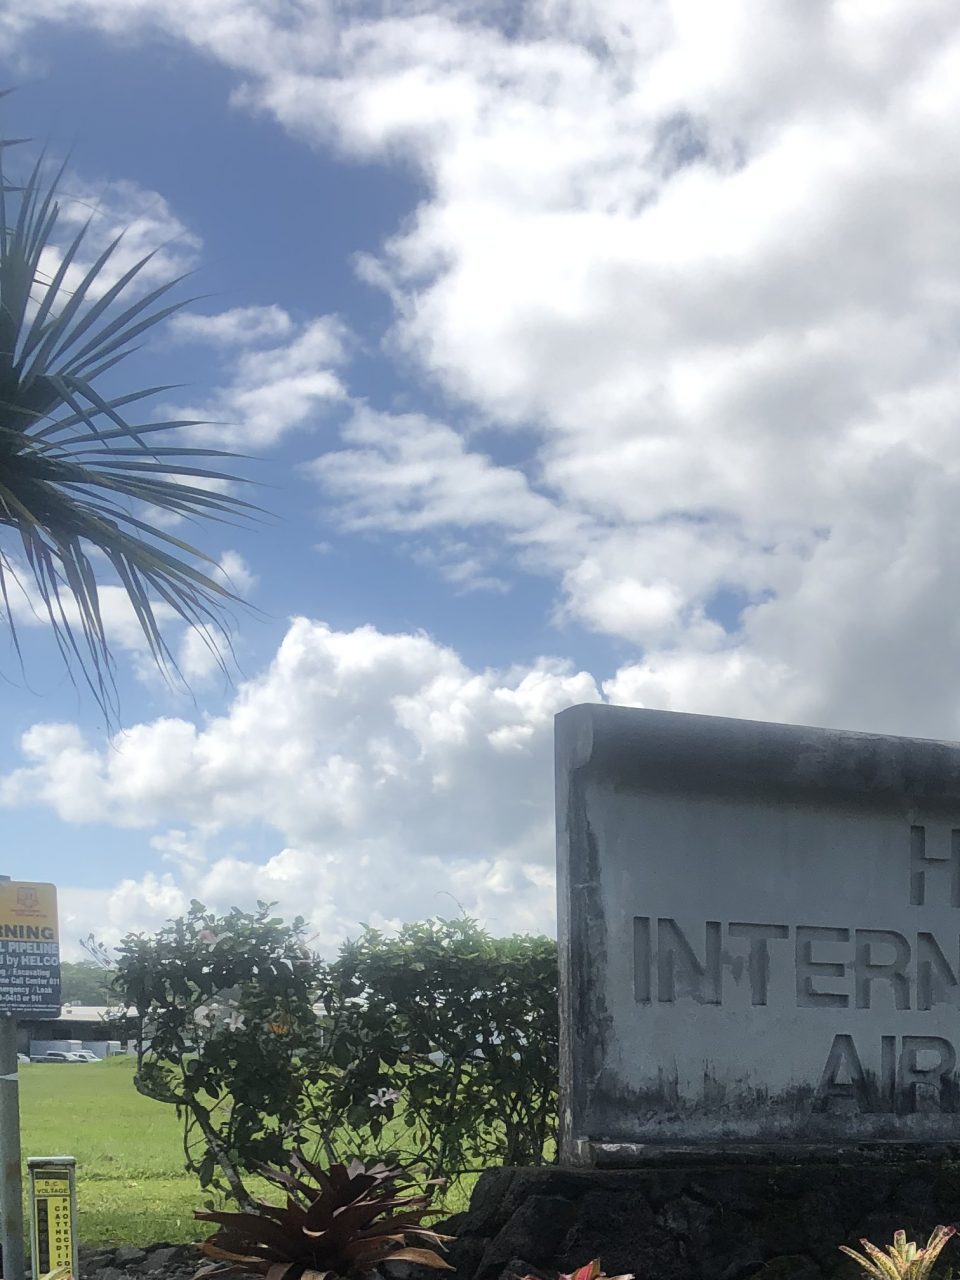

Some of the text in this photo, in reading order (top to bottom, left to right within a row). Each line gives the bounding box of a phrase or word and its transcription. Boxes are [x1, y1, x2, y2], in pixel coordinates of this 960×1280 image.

[9, 942, 59, 953] PIPELINE
[7, 954, 19, 967] by
[21, 955, 58, 966] HELCO
[11, 976, 24, 984] Call
[25, 977, 47, 985] Center
[36, 986, 52, 994] Leak
[54, 1205, 63, 1267] CATHODIC
